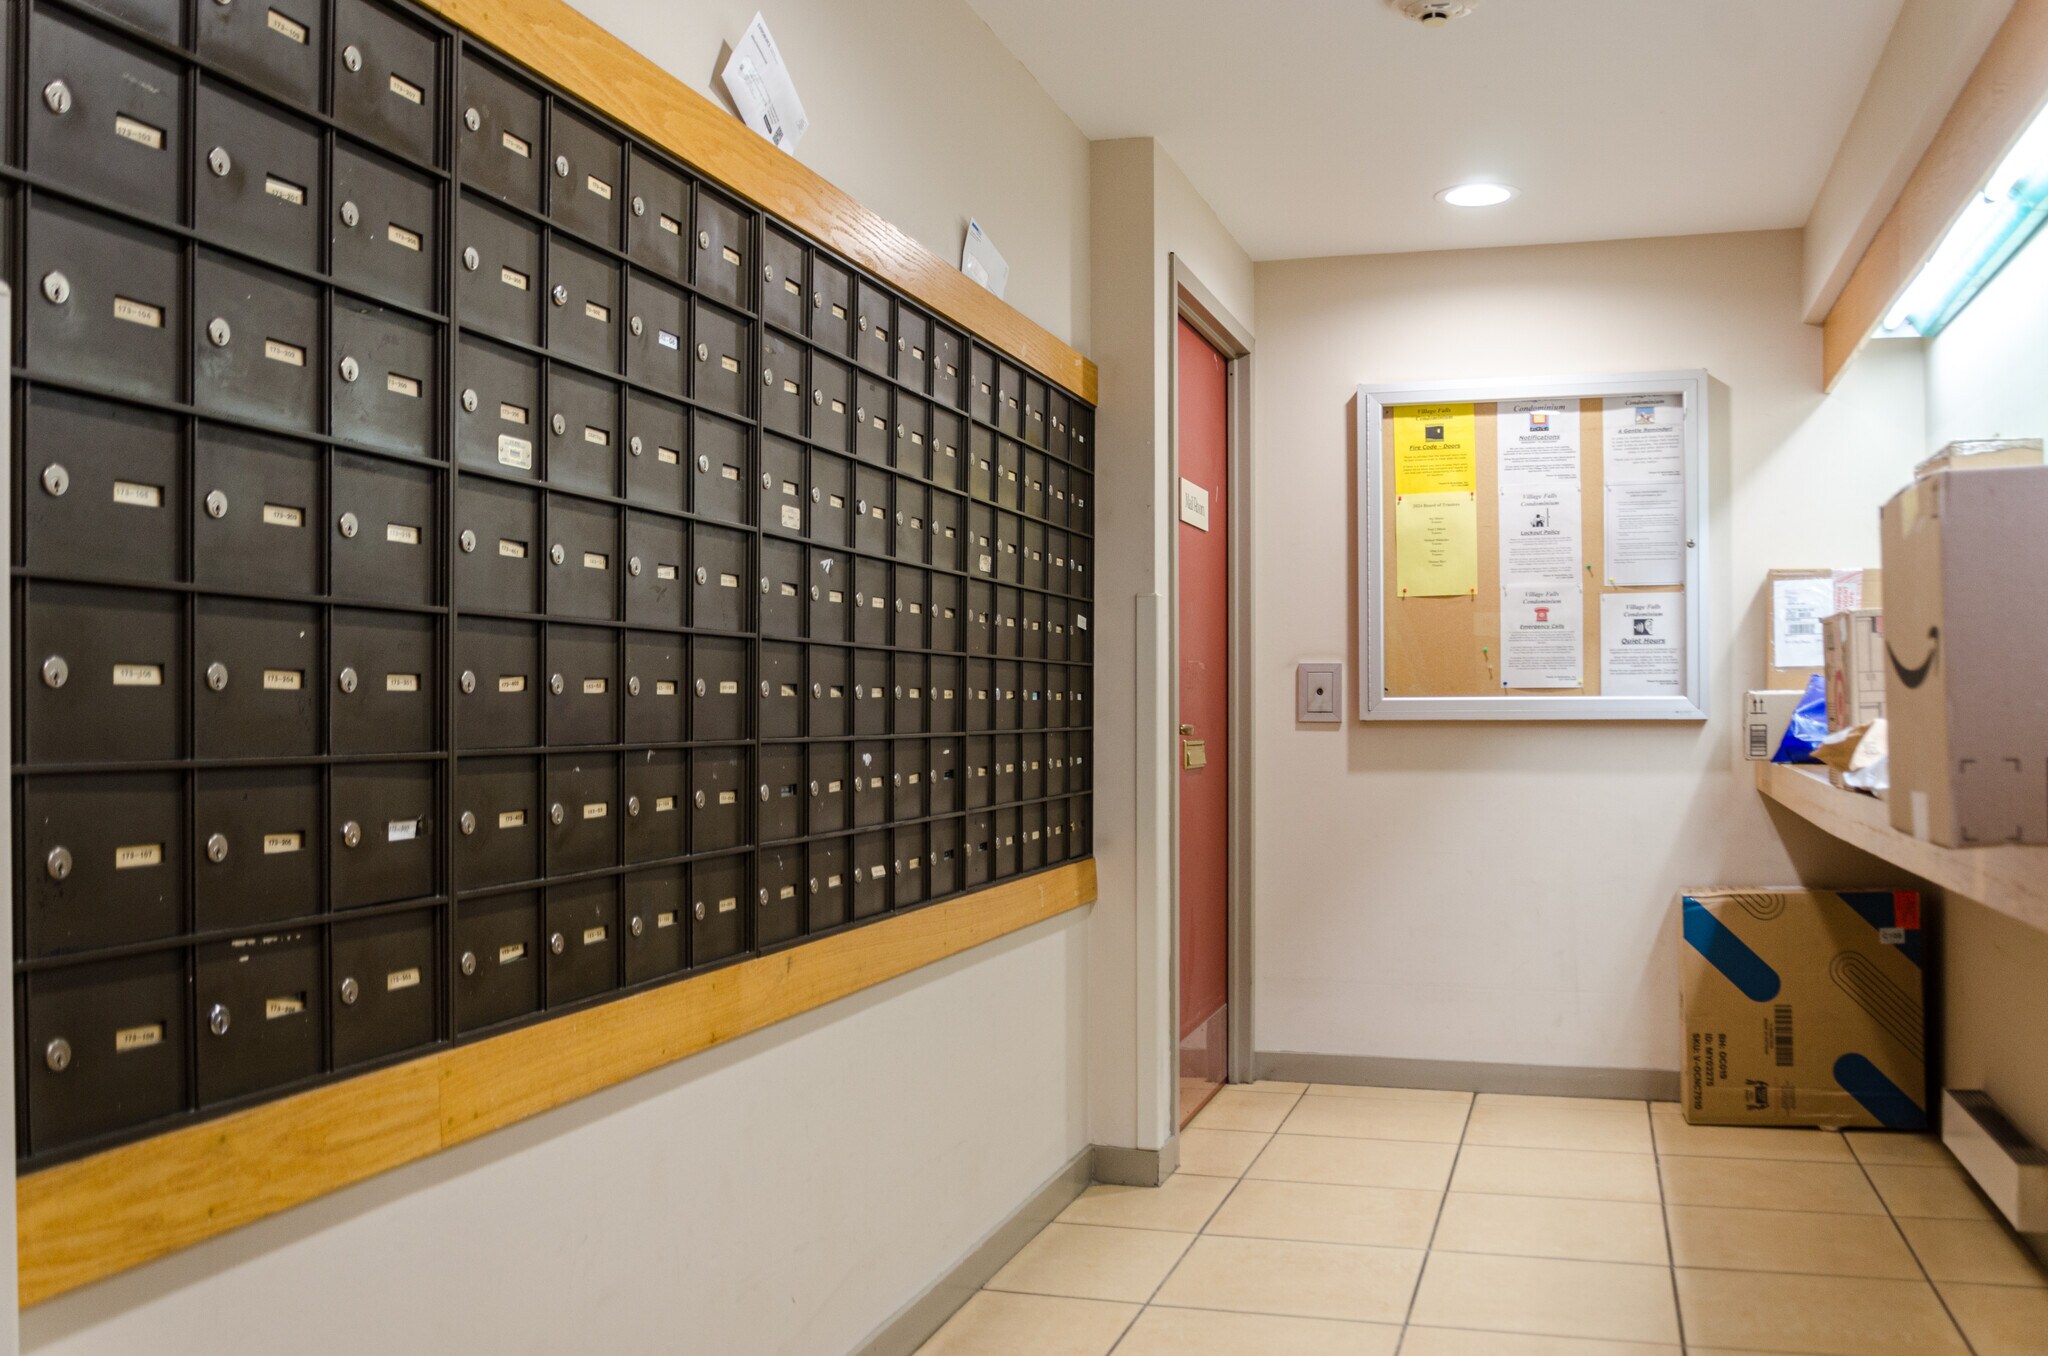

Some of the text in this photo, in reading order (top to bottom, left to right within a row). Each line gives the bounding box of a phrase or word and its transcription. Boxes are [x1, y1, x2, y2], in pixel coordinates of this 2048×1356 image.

[1514, 404, 1566, 413] Condominium
[1692, 1033, 1700, 1053] SKU:
[1705, 1033, 1713, 1044] ID:
